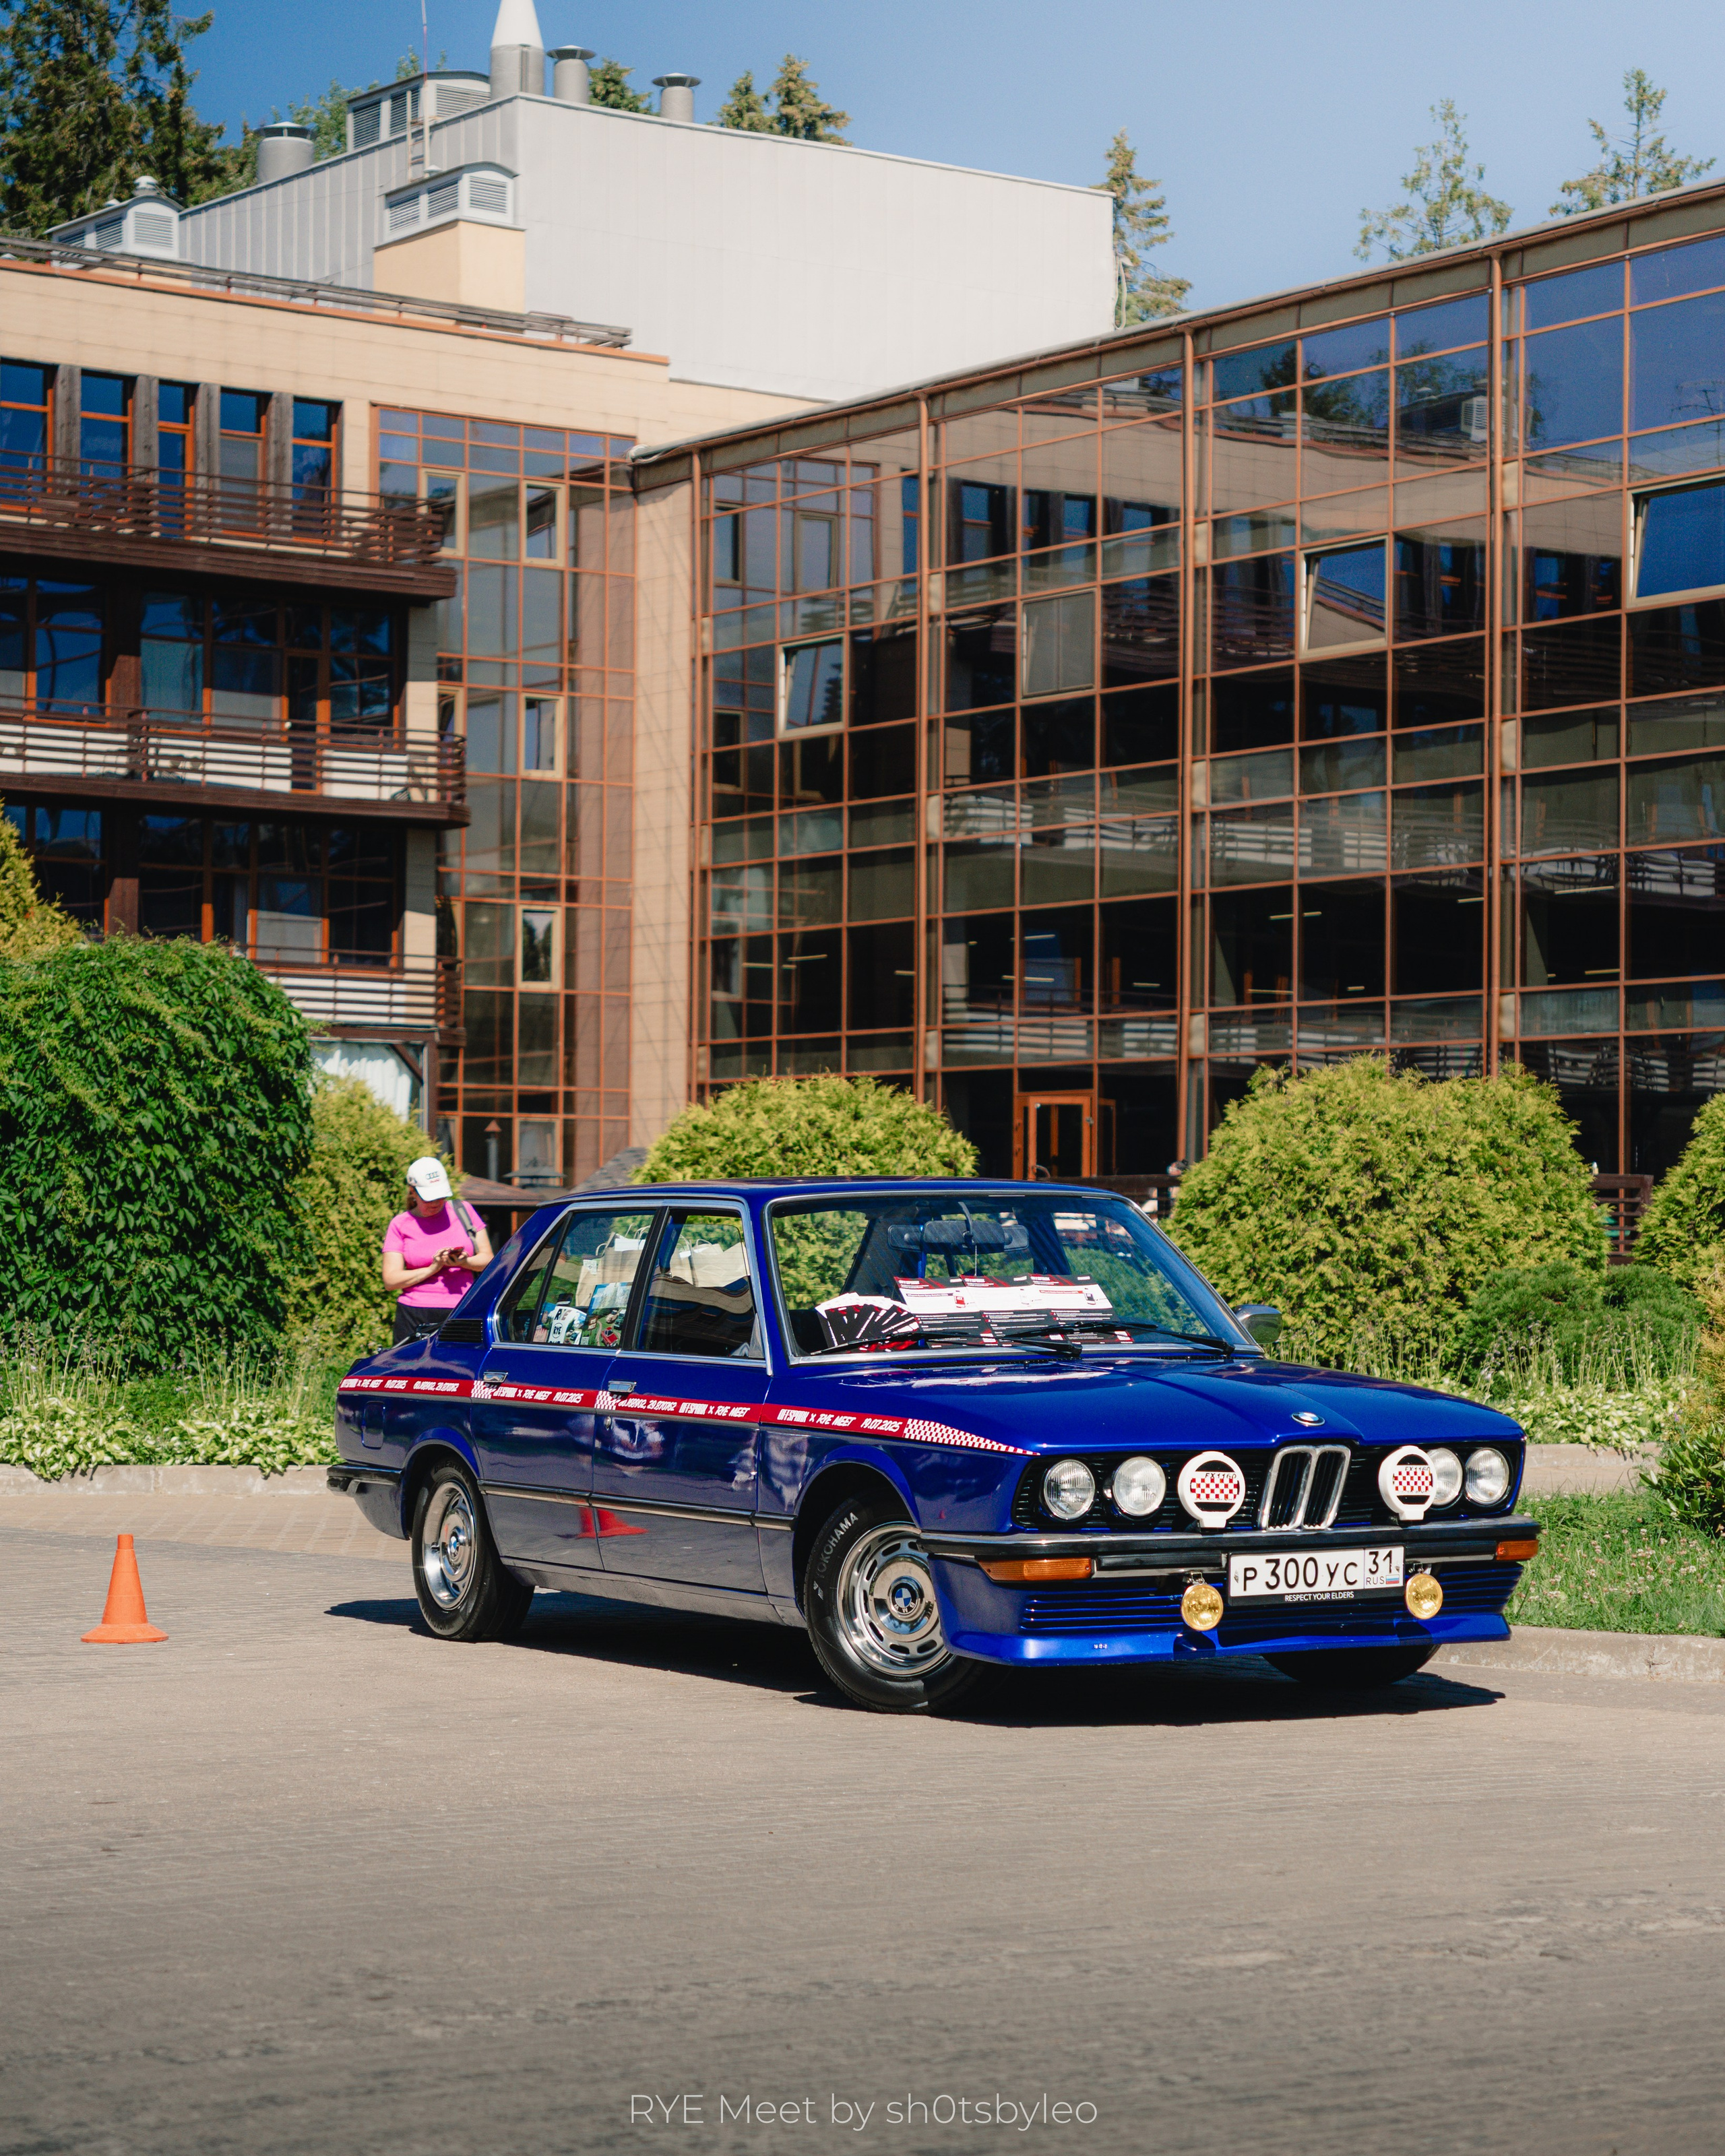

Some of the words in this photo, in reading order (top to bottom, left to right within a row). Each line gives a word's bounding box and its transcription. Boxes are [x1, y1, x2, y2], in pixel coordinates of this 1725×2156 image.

[555, 1308, 572, 1321] RYE
[553, 1325, 562, 1335] RYE
[522, 1389, 534, 1399] RYE
[534, 1391, 553, 1401] MEET
[714, 1405, 730, 1416] RYE
[728, 1406, 750, 1418] MEET
[816, 1414, 834, 1425] RYE
[832, 1416, 856, 1427] MEET
[860, 1418, 903, 1432] 19.07.2025
[816, 1512, 858, 1579] YOKOHAMA
[1369, 1550, 1393, 1575] 31
[1366, 1576, 1385, 1586] RUS
[1285, 1593, 1312, 1602] RESPECT
[1313, 1592, 1331, 1601] YOUR
[1331, 1591, 1354, 1599] ELDERS
[893, 1602, 916, 1614] BMW
